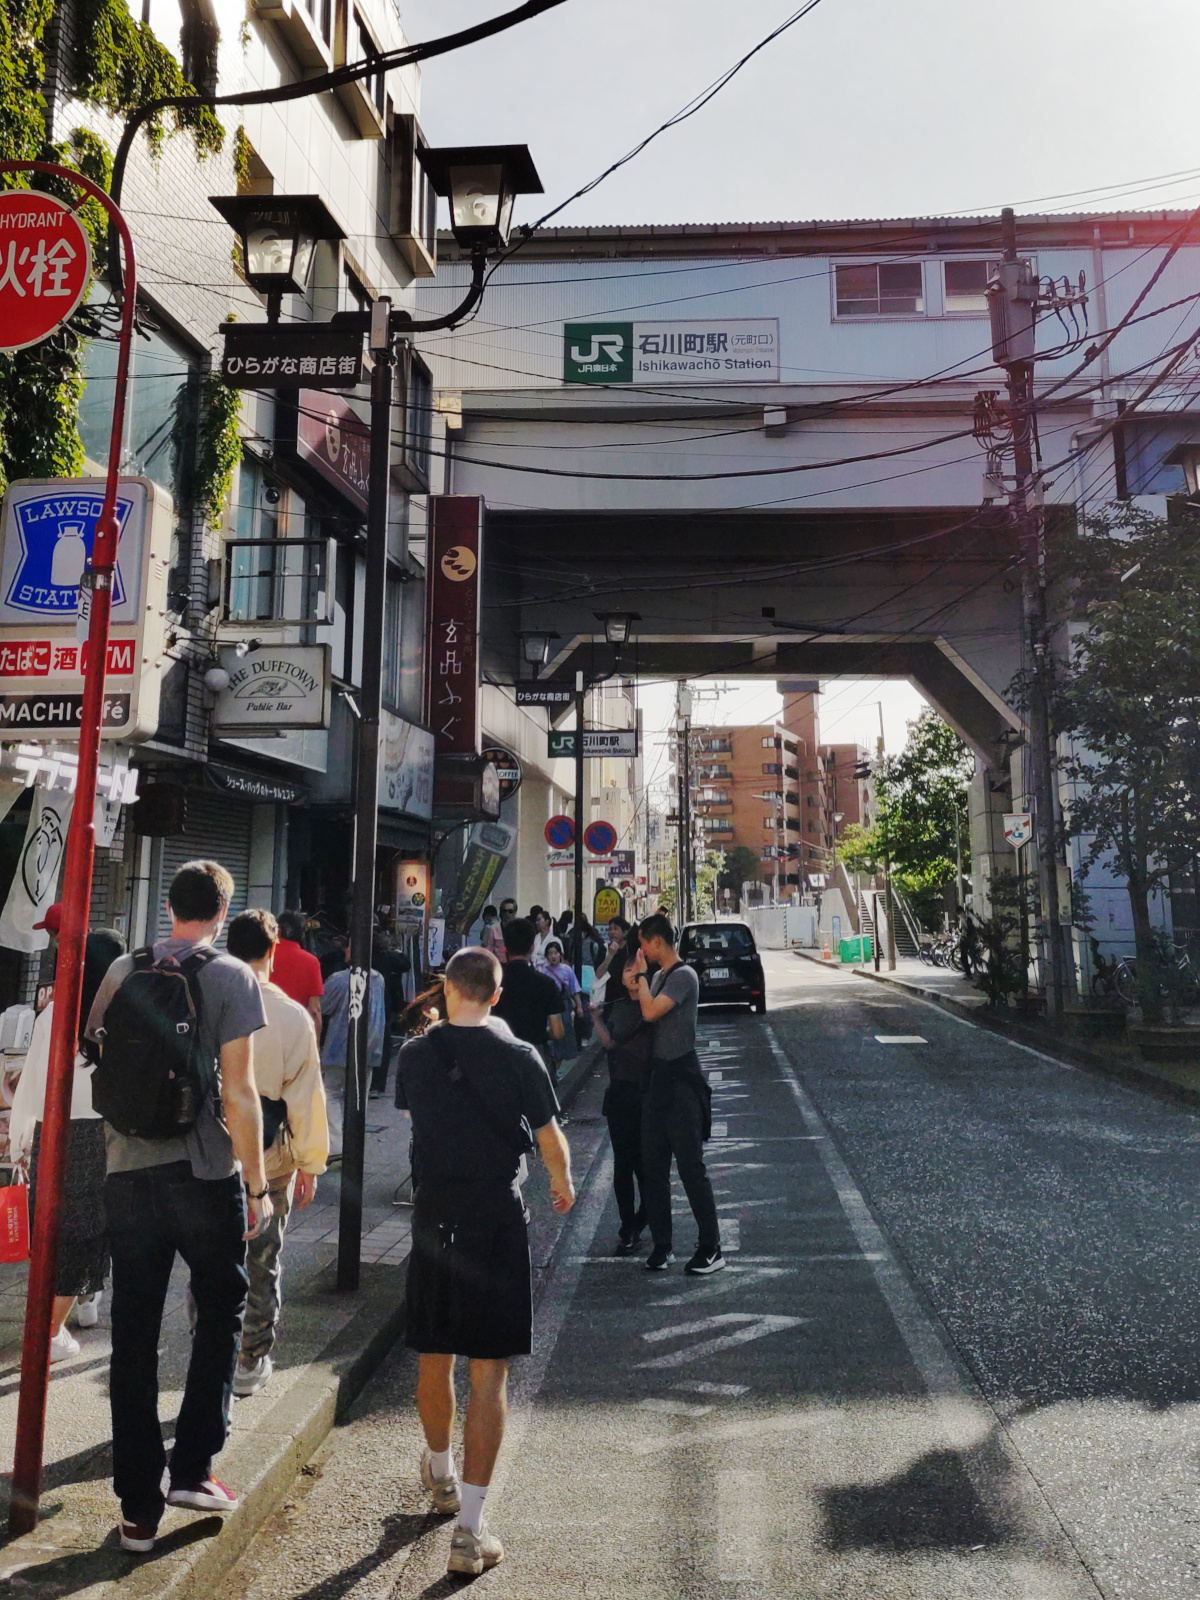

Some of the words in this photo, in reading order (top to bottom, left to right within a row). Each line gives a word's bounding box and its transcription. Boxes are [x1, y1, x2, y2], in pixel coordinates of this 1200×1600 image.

[0, 212, 66, 229] HYDRANT
[571, 334, 624, 363] JR
[639, 333, 728, 355] 石川町駅
[227, 356, 356, 375] ひらがな商店街
[578, 364, 617, 373] JR東日本
[725, 357, 771, 369] Station
[25, 501, 119, 523] LAWSO
[19, 585, 79, 606] STATI
[78, 601, 90, 621] 7m
[0, 645, 48, 671] たばこ
[53, 647, 78, 670] 酒
[227, 668, 249, 692] THE
[252, 660, 318, 692] DUFFTOWN
[439, 618, 461, 741] 玄品ふぐ
[517, 692, 570, 701] ひらがな商店街
[0, 702, 72, 721] MACHI
[246, 702, 273, 711] Public
[276, 702, 292, 711] Bar
[552, 736, 575, 749] JR
[38, 986, 53, 1000] OP
